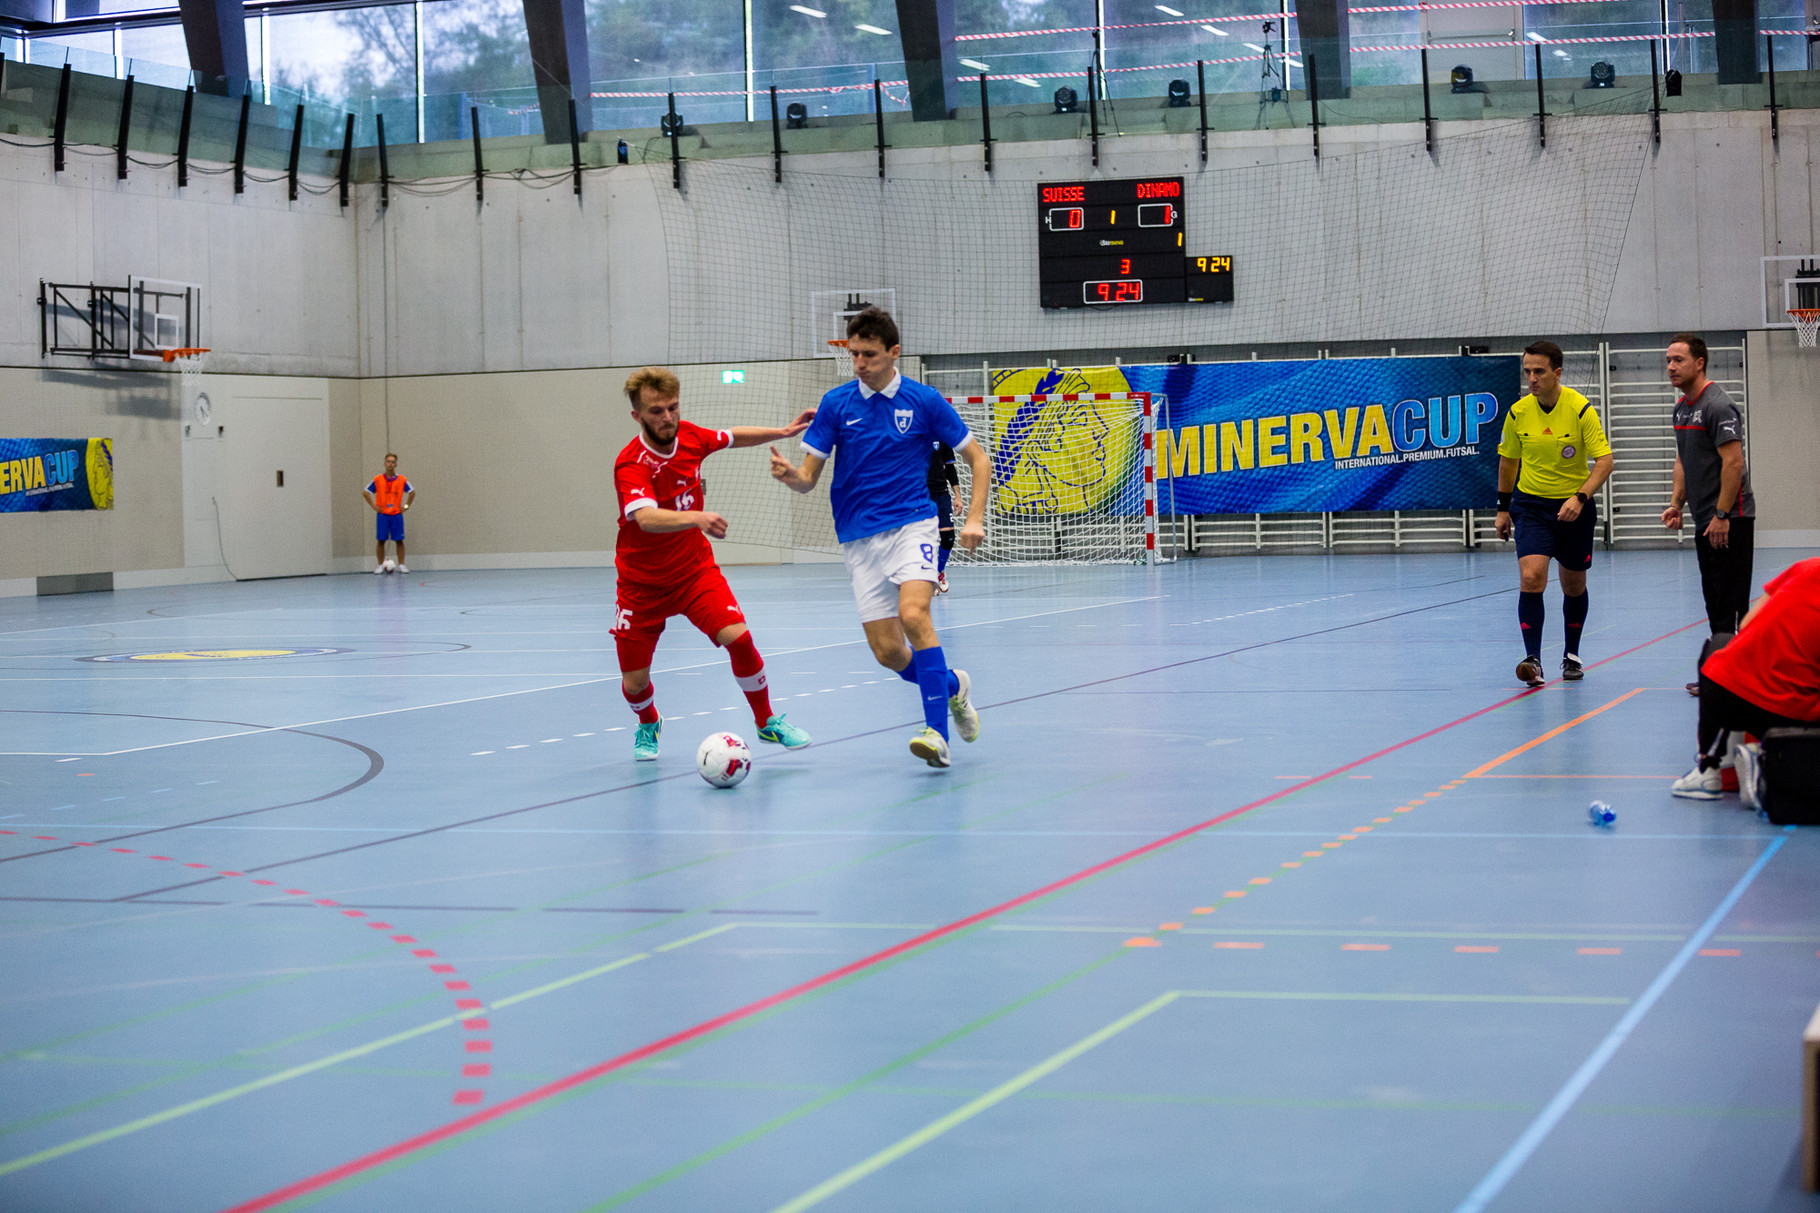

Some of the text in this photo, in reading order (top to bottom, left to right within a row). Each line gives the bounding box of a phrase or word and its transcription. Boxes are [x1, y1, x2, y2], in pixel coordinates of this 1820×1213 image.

[1042, 186, 1085, 203] SUISSE
[1136, 181, 1180, 199] DINAMO
[1068, 209, 1082, 229] 0
[1170, 210, 1178, 219] G
[1120, 258, 1131, 275] 3
[920, 543, 934, 564] 8
